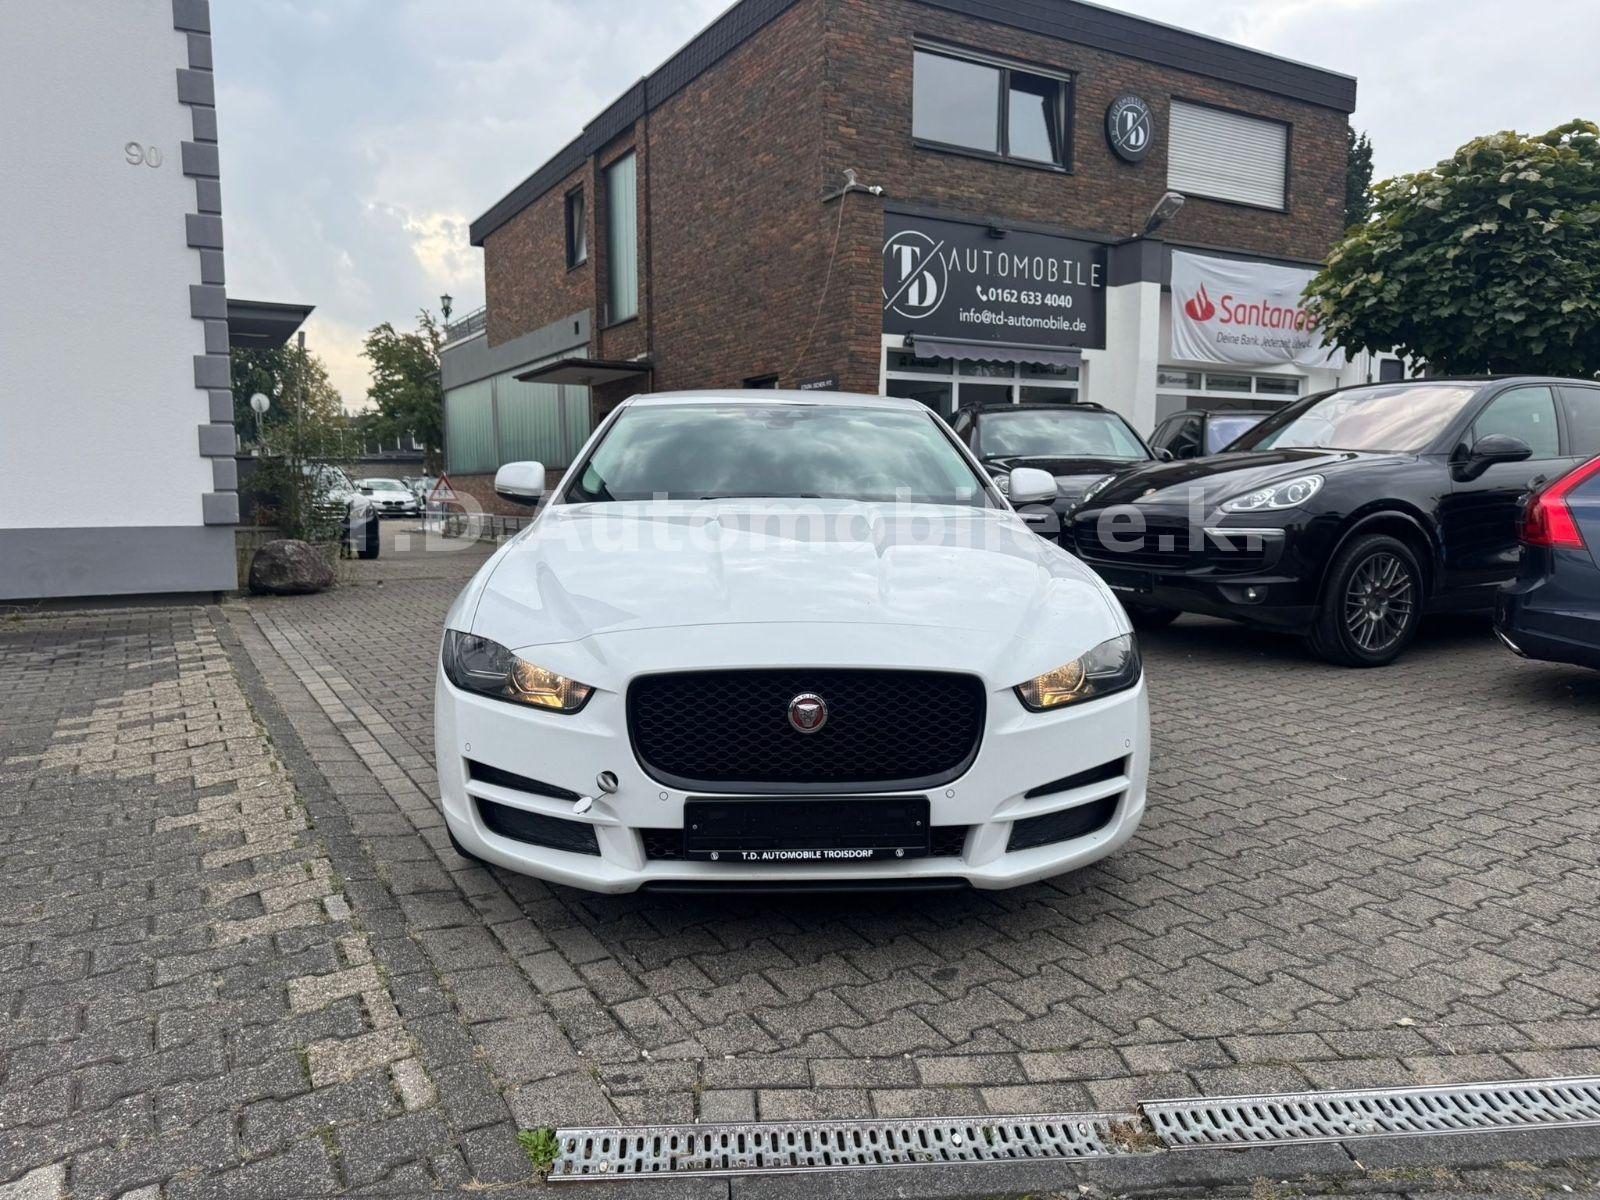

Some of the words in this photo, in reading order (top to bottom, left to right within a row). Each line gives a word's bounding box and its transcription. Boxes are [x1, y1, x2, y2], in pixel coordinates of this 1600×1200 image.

[125, 141, 162, 169] 90
[948, 247, 1101, 287] AUTOMOBILE
[988, 288, 1018, 303] 0162
[1021, 291, 1043, 304] 633
[1044, 292, 1072, 308] 4040
[959, 307, 1087, 332] info@td-automobile.de
[1220, 295, 1318, 332] Santane
[742, 852, 760, 860] T.D.
[762, 851, 822, 860] AUTOMOBILE
[824, 849, 874, 859] TROISDORF
